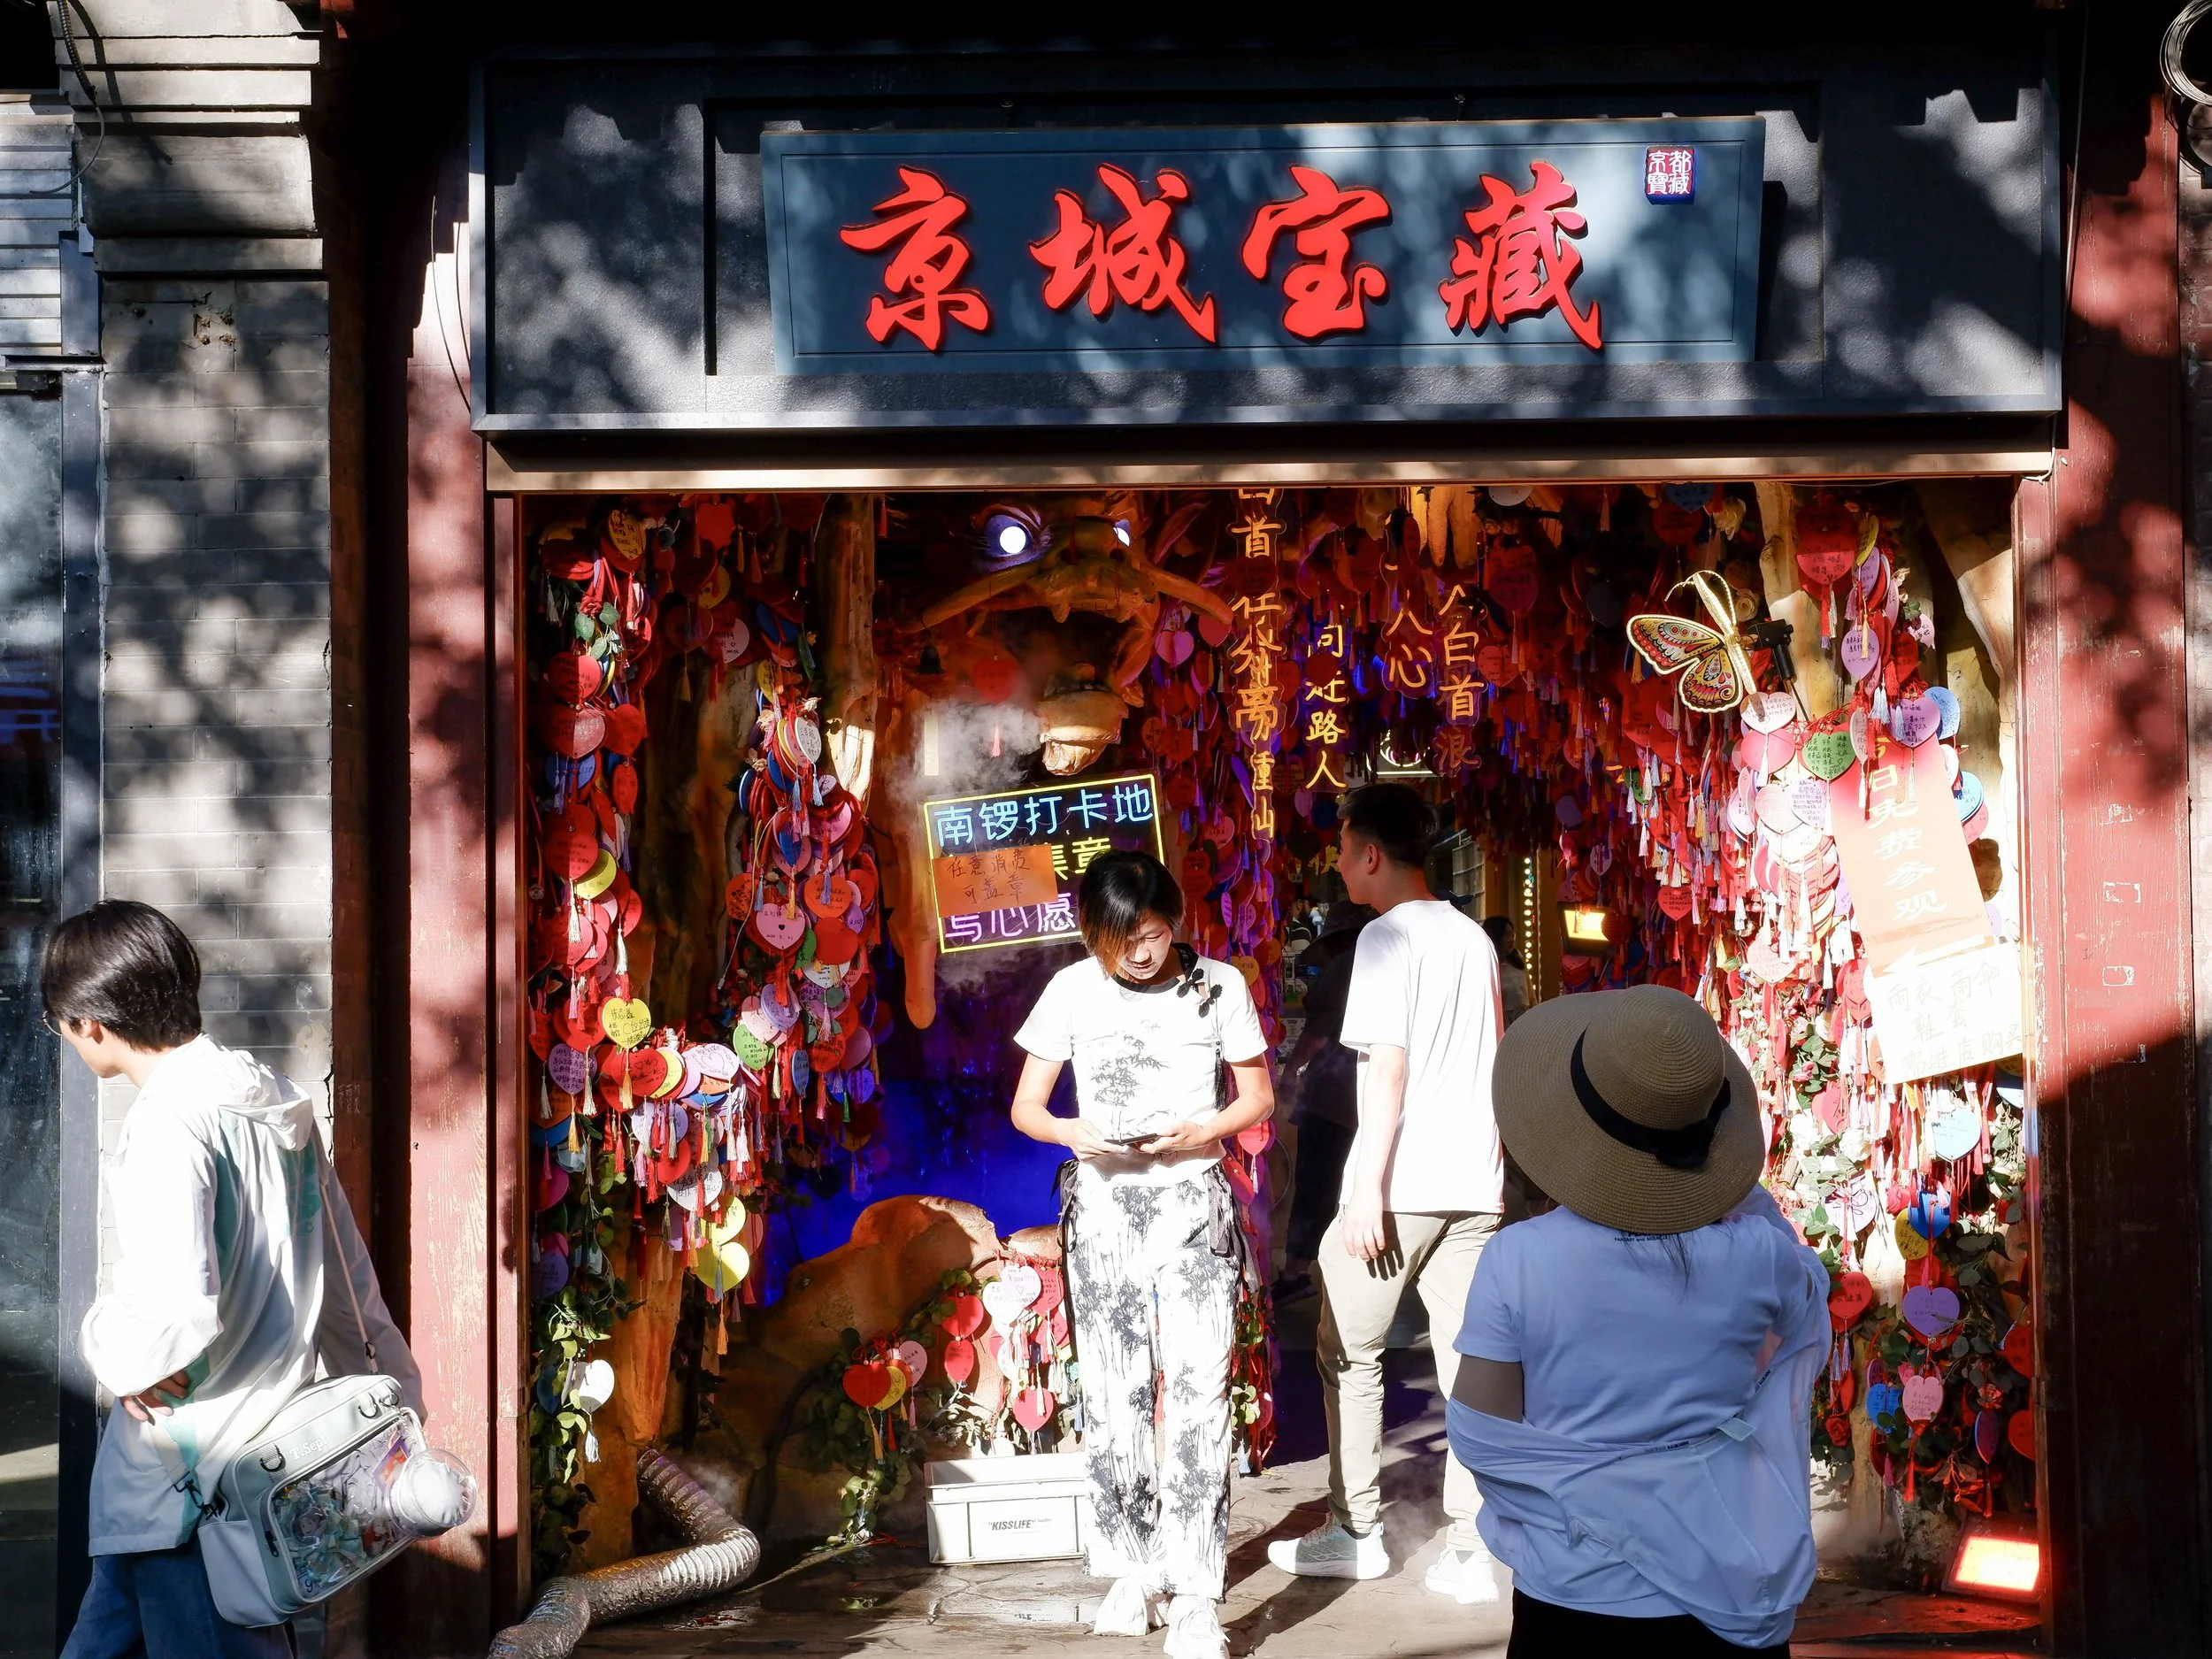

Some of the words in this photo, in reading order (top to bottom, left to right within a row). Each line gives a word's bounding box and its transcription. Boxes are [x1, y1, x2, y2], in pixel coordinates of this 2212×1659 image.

[839, 161, 1603, 351] 京城宝藏
[933, 783, 1154, 847] 南锣打卡地
[947, 849, 1031, 879] 任意消费
[964, 873, 1024, 905] 可盖章
[1911, 999, 1969, 1044] 鞋套
